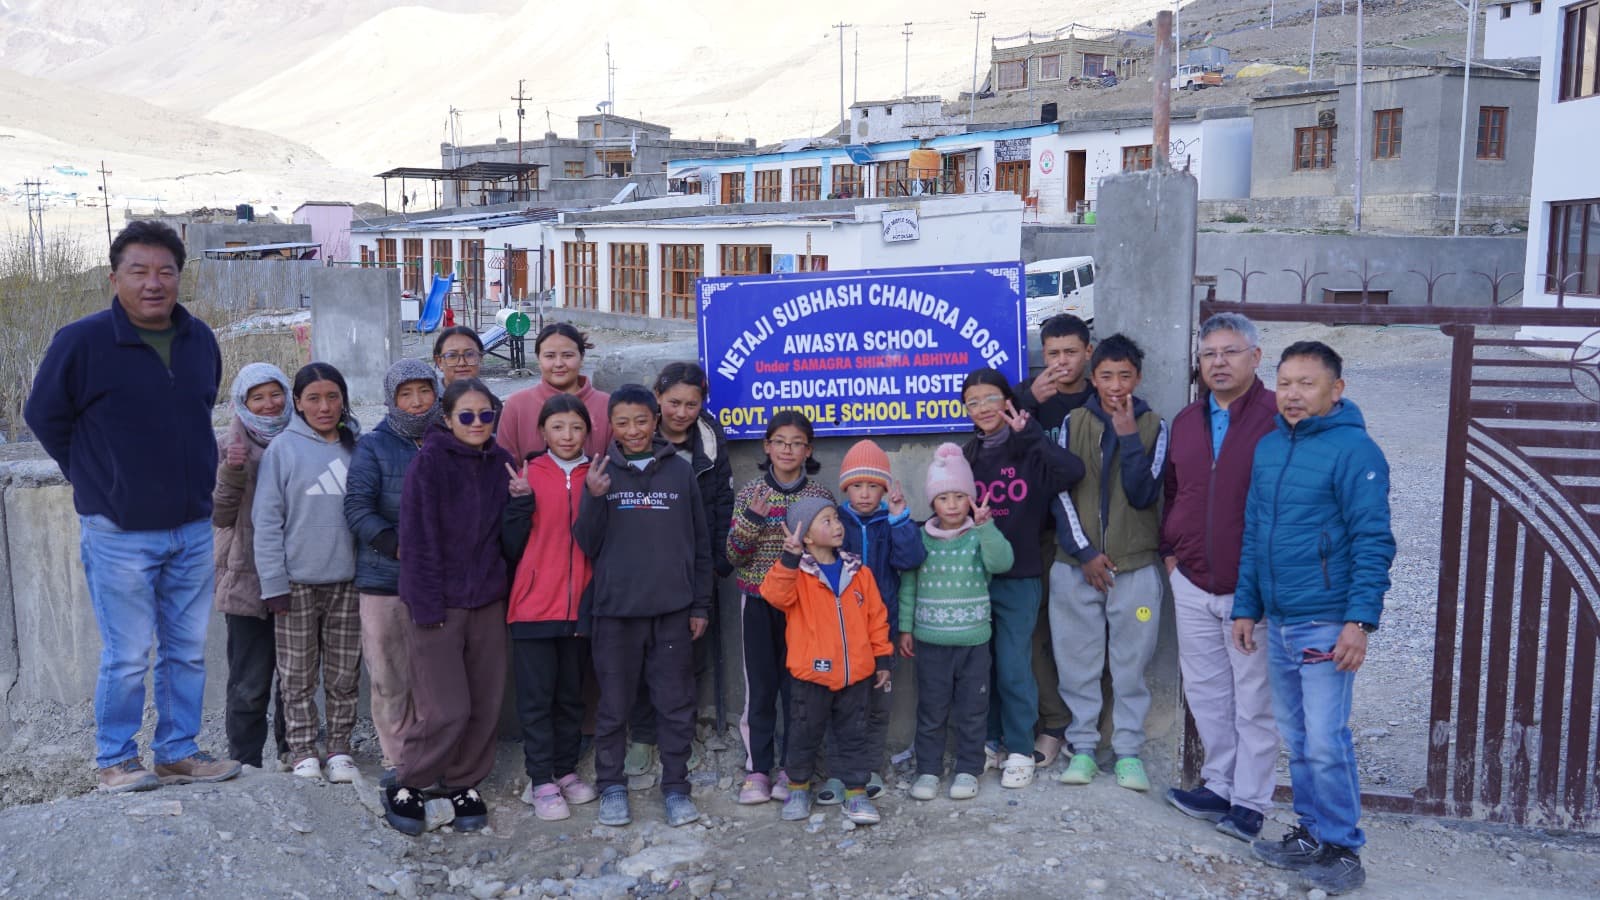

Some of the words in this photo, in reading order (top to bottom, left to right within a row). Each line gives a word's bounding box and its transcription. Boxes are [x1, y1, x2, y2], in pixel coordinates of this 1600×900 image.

[717, 315, 775, 382] NETAJI
[772, 283, 863, 329] SUBHASH
[869, 283, 960, 330] CHANDRA
[959, 316, 1009, 370] BOSE
[783, 332, 859, 355] AWASYA
[863, 329, 939, 352] SCHOOL
[755, 360, 790, 373] Under
[793, 356, 852, 372] SAMAGRA
[855, 354, 910, 369] SHIKSHA
[913, 352, 969, 367] ABHIYAN
[751, 376, 901, 400] CO-EDUCATIONAL
[905, 373, 968, 395] HOSTE
[719, 406, 768, 426] GOVT.
[772, 404, 836, 423] DLE
[841, 401, 912, 422] SCHOOL
[606, 492, 634, 500] UNITED
[636, 491, 668, 499] CLORS
[669, 493, 679, 501] OF
